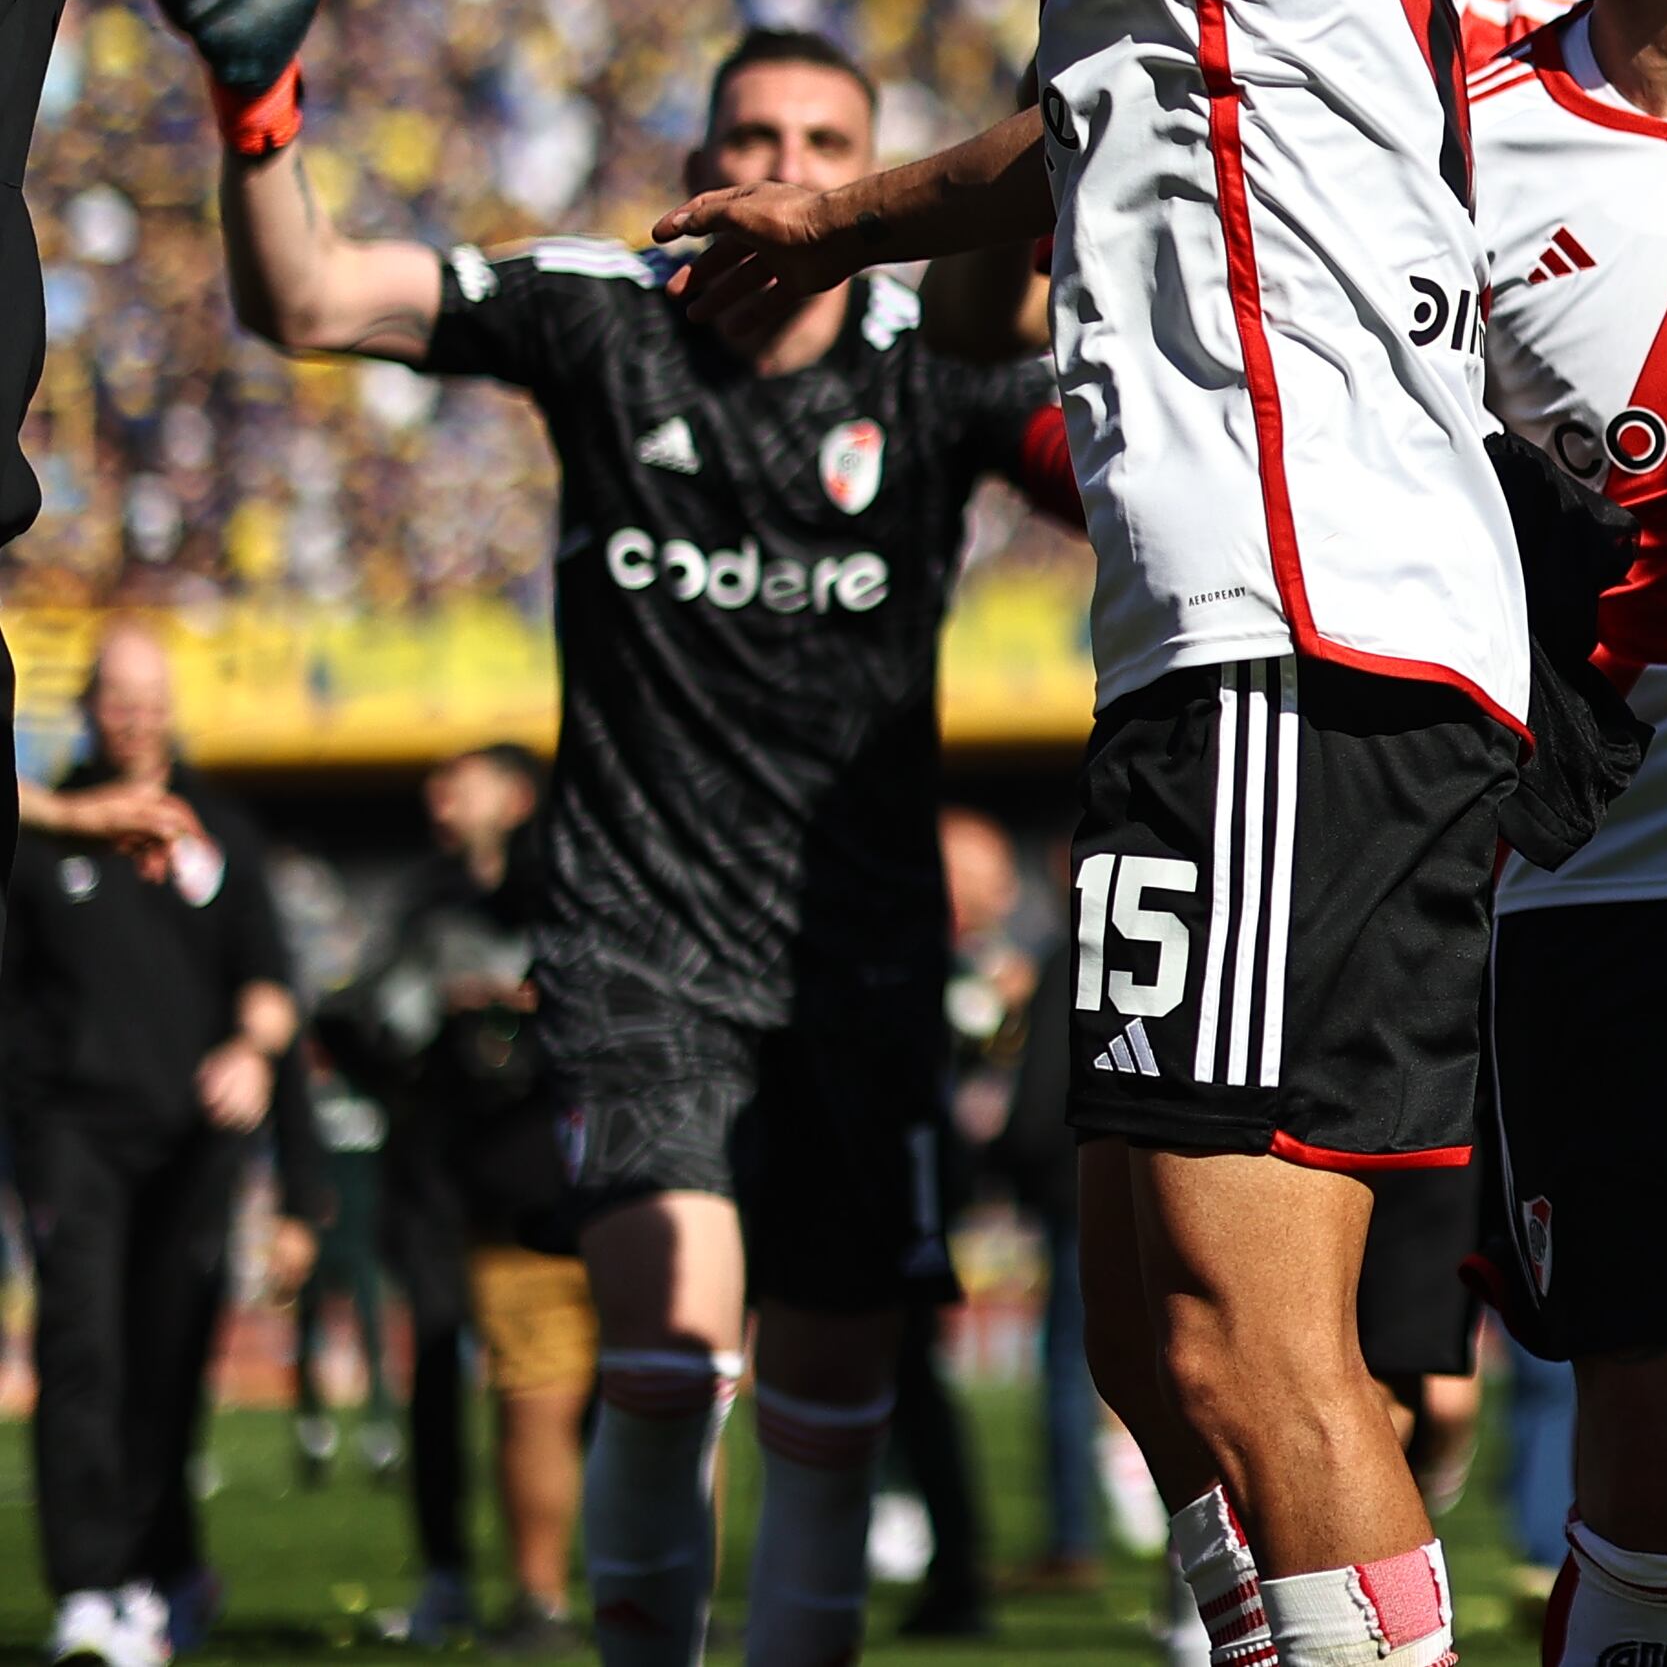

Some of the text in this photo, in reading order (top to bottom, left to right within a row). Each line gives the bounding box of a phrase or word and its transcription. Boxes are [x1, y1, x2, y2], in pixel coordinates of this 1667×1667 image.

[606, 526, 889, 614] codere
[1188, 586, 1246, 607] AEROREADY
[1075, 853, 1198, 1018] 15
